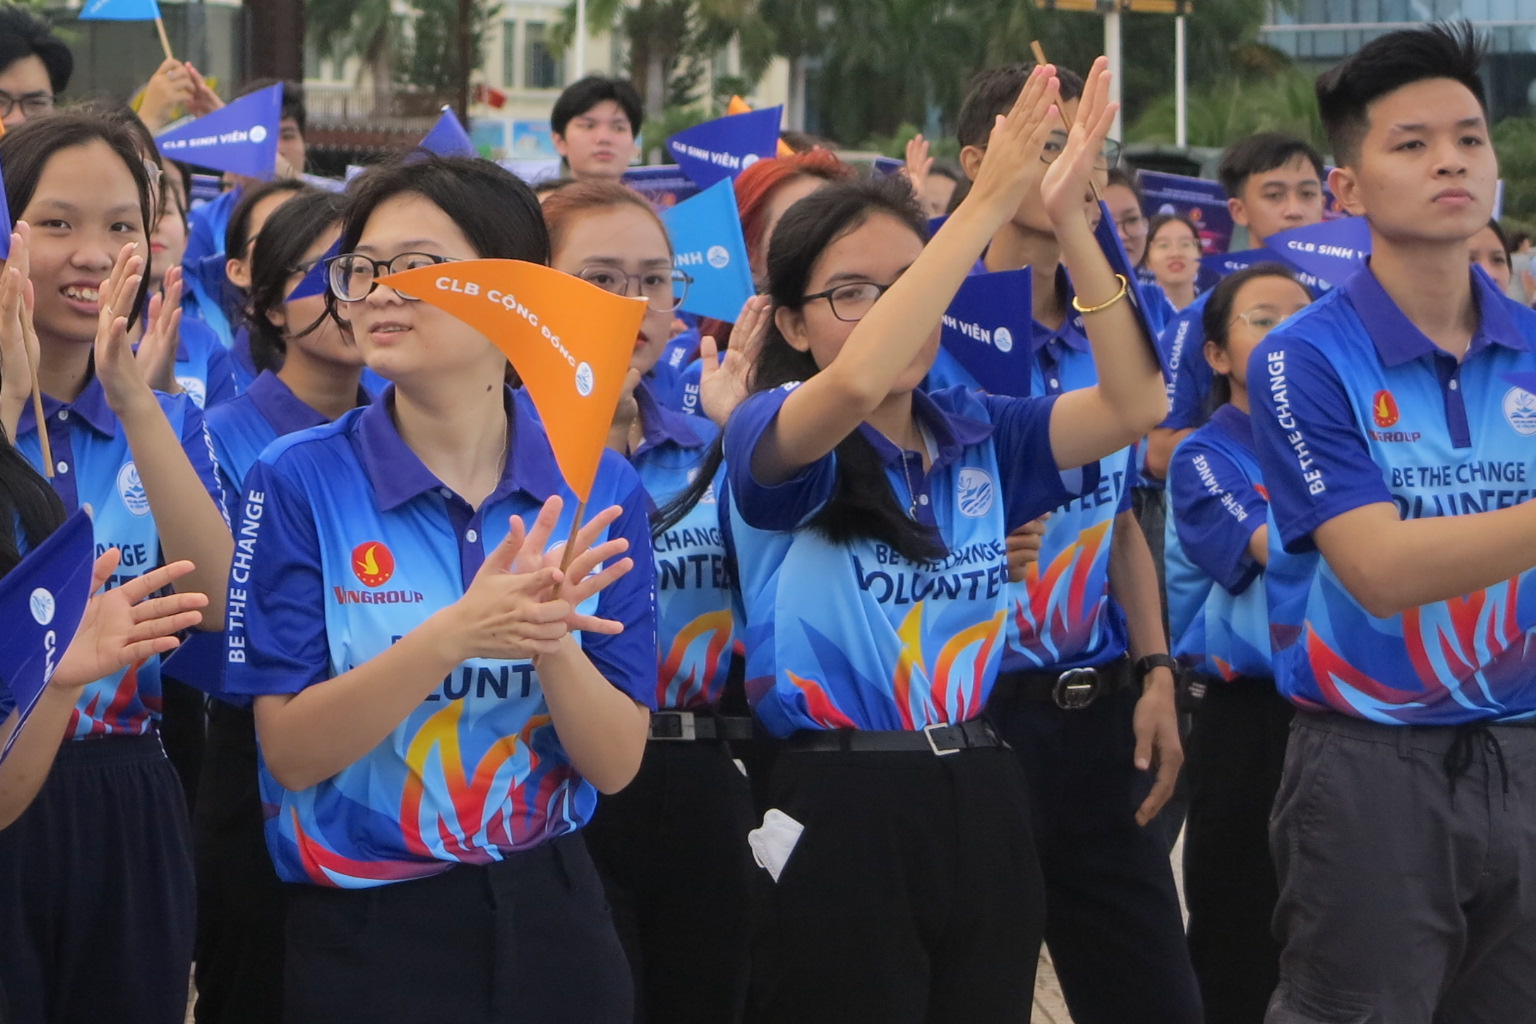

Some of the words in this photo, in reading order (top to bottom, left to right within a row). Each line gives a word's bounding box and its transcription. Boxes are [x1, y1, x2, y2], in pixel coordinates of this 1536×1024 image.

[188, 135, 217, 147] SINH
[219, 130, 248, 144] VIÊN
[711, 151, 740, 169] VIÊN
[673, 251, 703, 267] INH
[1287, 240, 1315, 252] CLB
[1318, 243, 1353, 259] SINH
[435, 276, 480, 296] CLB
[487, 290, 540, 327] CỘNG
[959, 320, 991, 345] VIÊN
[1268, 350, 1296, 429] CHANGE
[1287, 430, 1314, 470] THE
[1304, 468, 1326, 495] BE
[1392, 466, 1415, 487] BE
[1417, 465, 1451, 487] THE
[232, 489, 265, 584] CHANGE
[229, 587, 247, 632] THE
[228, 636, 246, 663] BE
